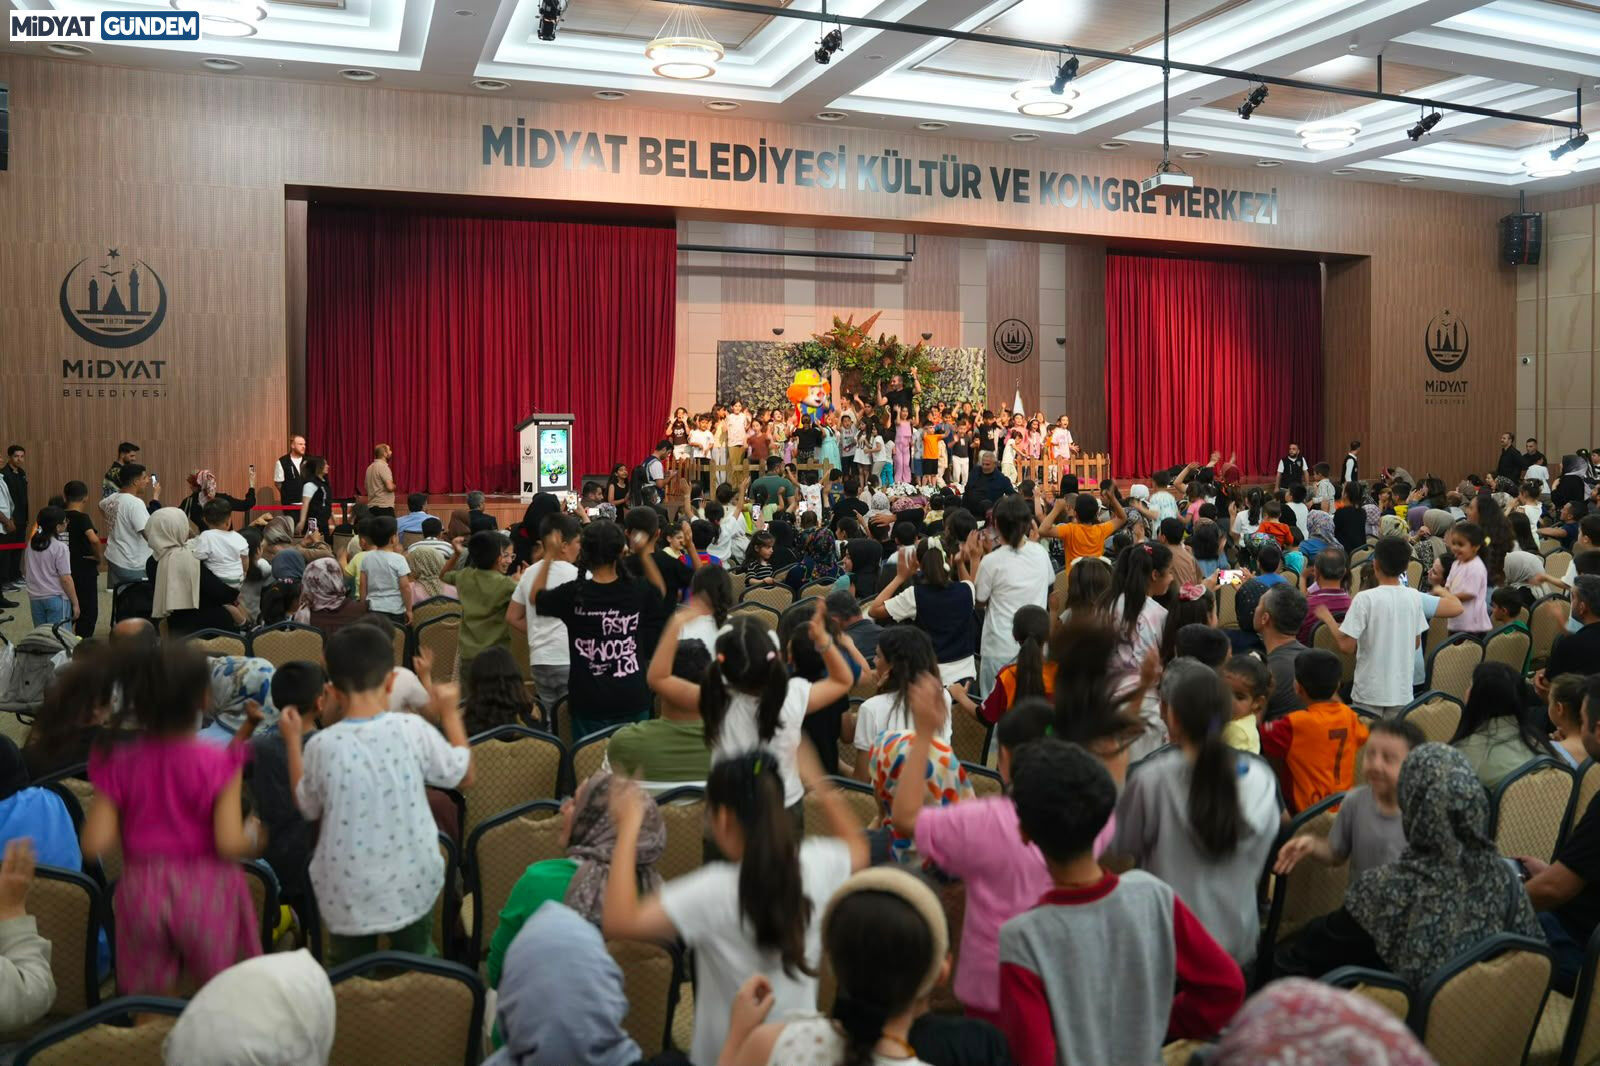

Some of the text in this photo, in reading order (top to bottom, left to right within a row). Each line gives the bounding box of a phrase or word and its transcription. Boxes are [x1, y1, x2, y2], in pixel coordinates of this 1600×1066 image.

[481, 117, 1278, 225] MİDYAT BELEDİYESİ KÜLTÜR VE KONGRE MERKEZİ
[1328, 728, 1348, 785] 7
